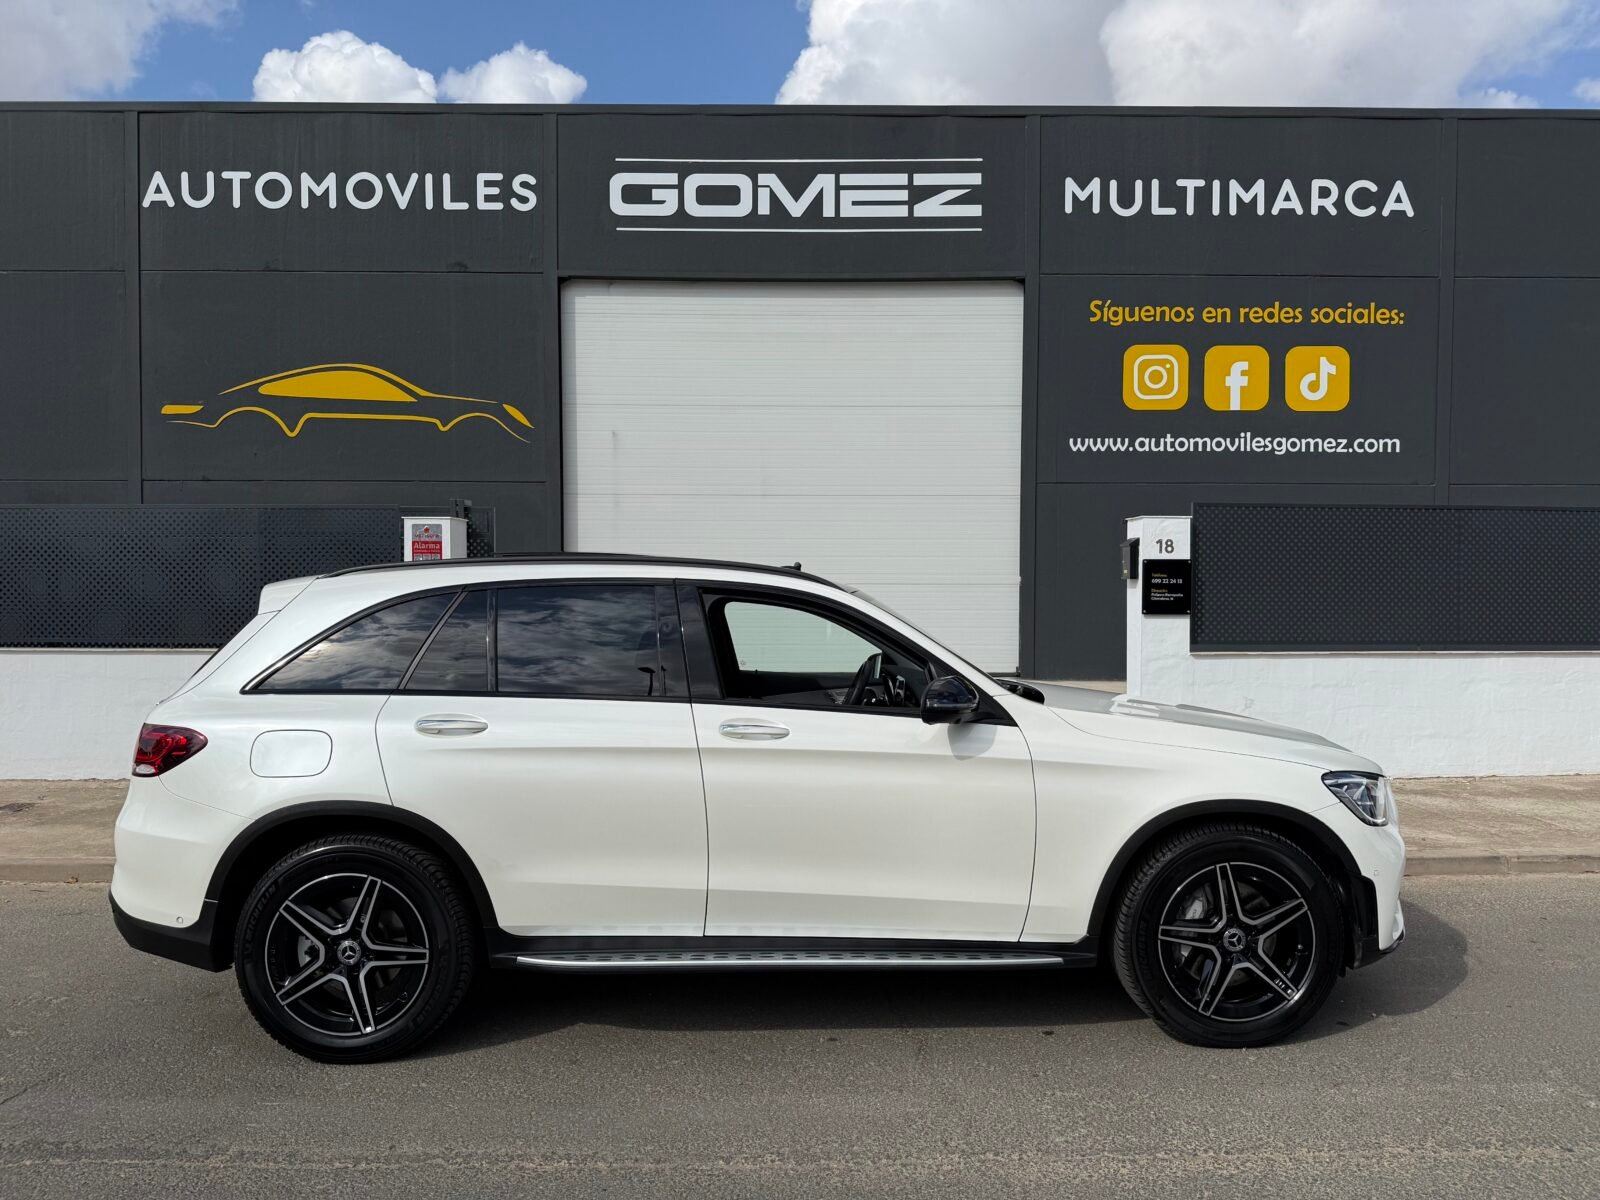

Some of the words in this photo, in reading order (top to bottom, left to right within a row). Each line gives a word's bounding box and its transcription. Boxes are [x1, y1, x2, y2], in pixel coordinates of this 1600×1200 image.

[142, 170, 537, 211] AUTOMOVILES
[609, 172, 983, 218] GOMEZ
[1064, 177, 1415, 218] MULTIMARCA
[1089, 299, 1195, 326] Síguenos
[1202, 306, 1231, 324] en
[1239, 301, 1303, 324] redes
[1311, 302, 1405, 325] sociales:
[1069, 431, 1401, 455] www.automovilesgomez.com
[1155, 538, 1175, 554] 18
